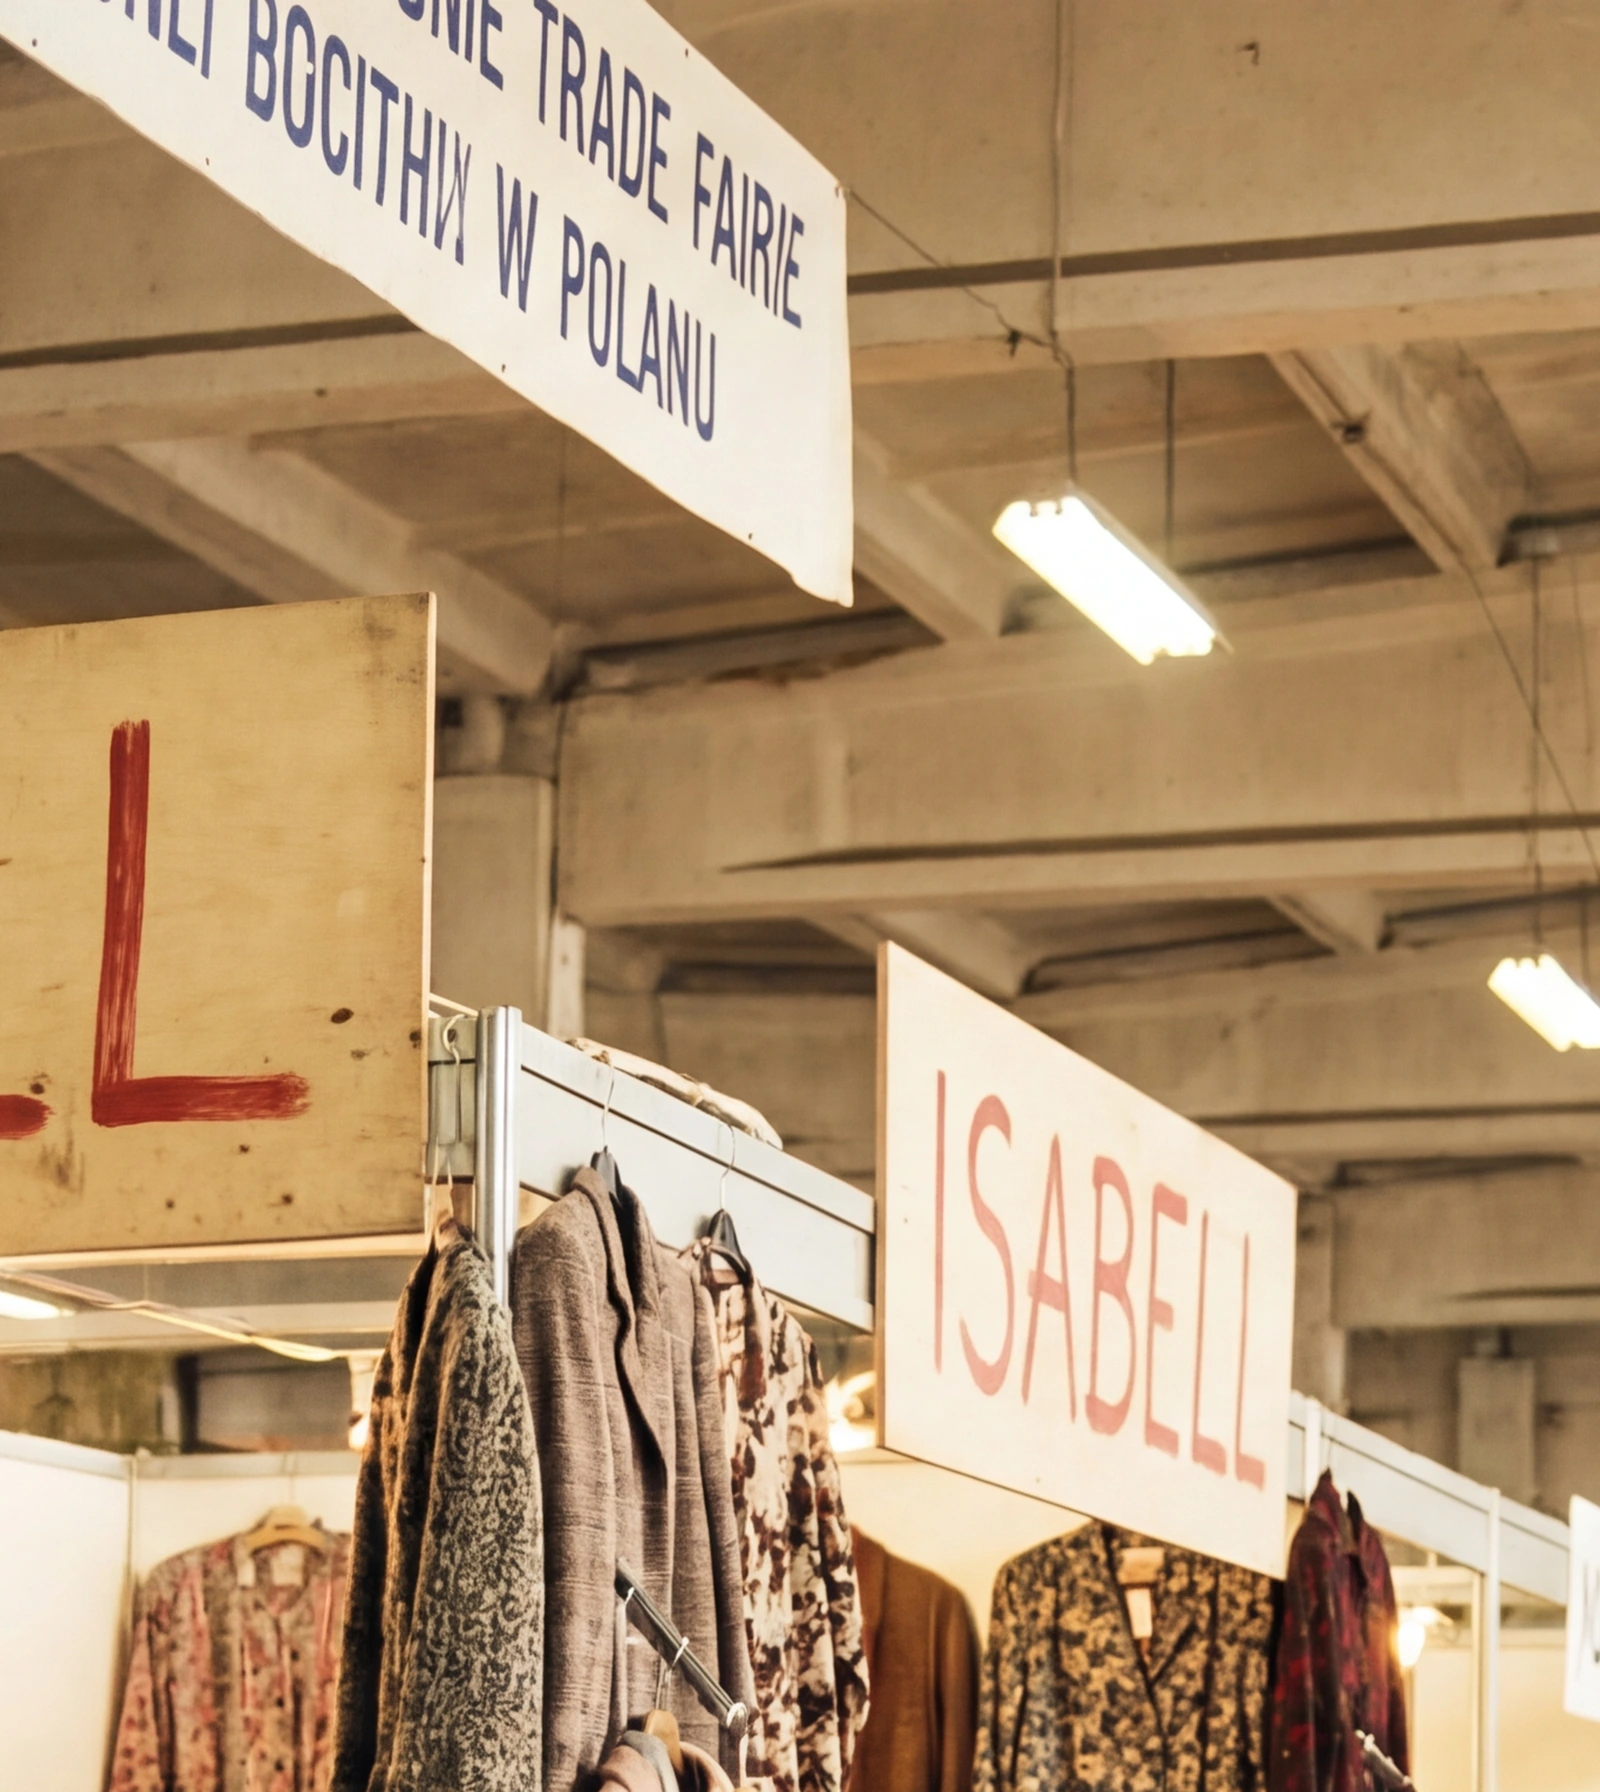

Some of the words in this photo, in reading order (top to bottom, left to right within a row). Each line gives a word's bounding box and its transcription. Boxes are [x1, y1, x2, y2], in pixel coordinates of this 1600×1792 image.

[397, 0, 504, 91] IE
[532, 0, 672, 225] TRADE
[692, 130, 805, 330] FAIRIE
[496, 162, 539, 314] W
[560, 213, 716, 443] POLANU
[934, 1068, 1267, 1492] ISABELL
